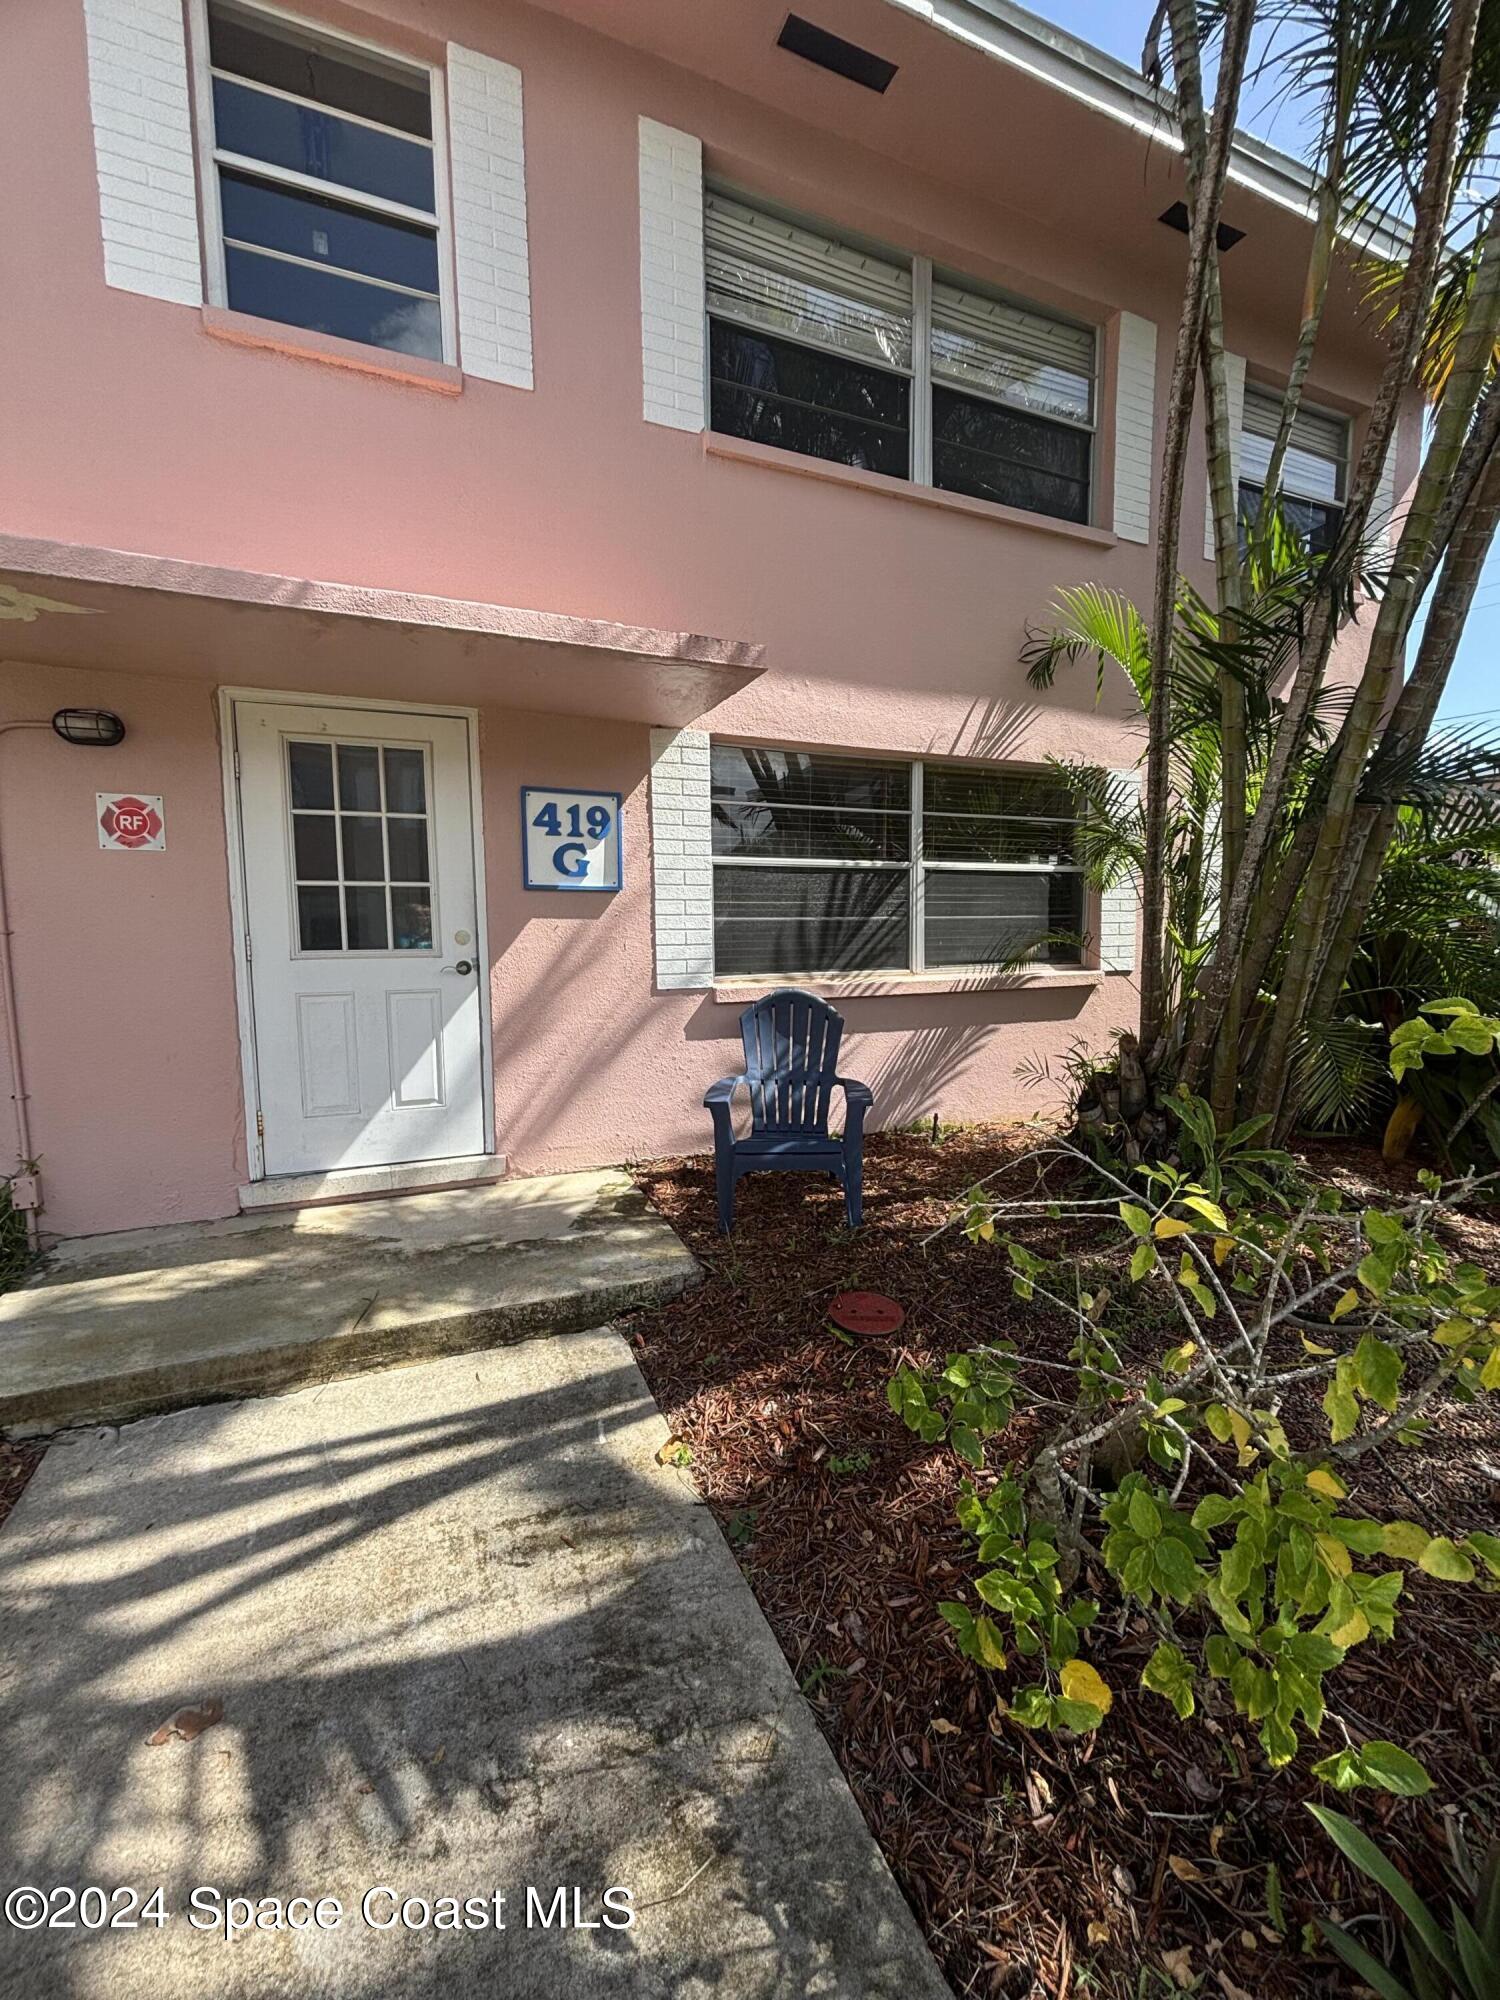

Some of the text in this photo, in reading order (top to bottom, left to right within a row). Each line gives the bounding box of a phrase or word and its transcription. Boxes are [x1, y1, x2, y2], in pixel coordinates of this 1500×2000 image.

[119, 815, 143, 830] RF
[532, 802, 611, 840] 419
[552, 842, 590, 878] G
